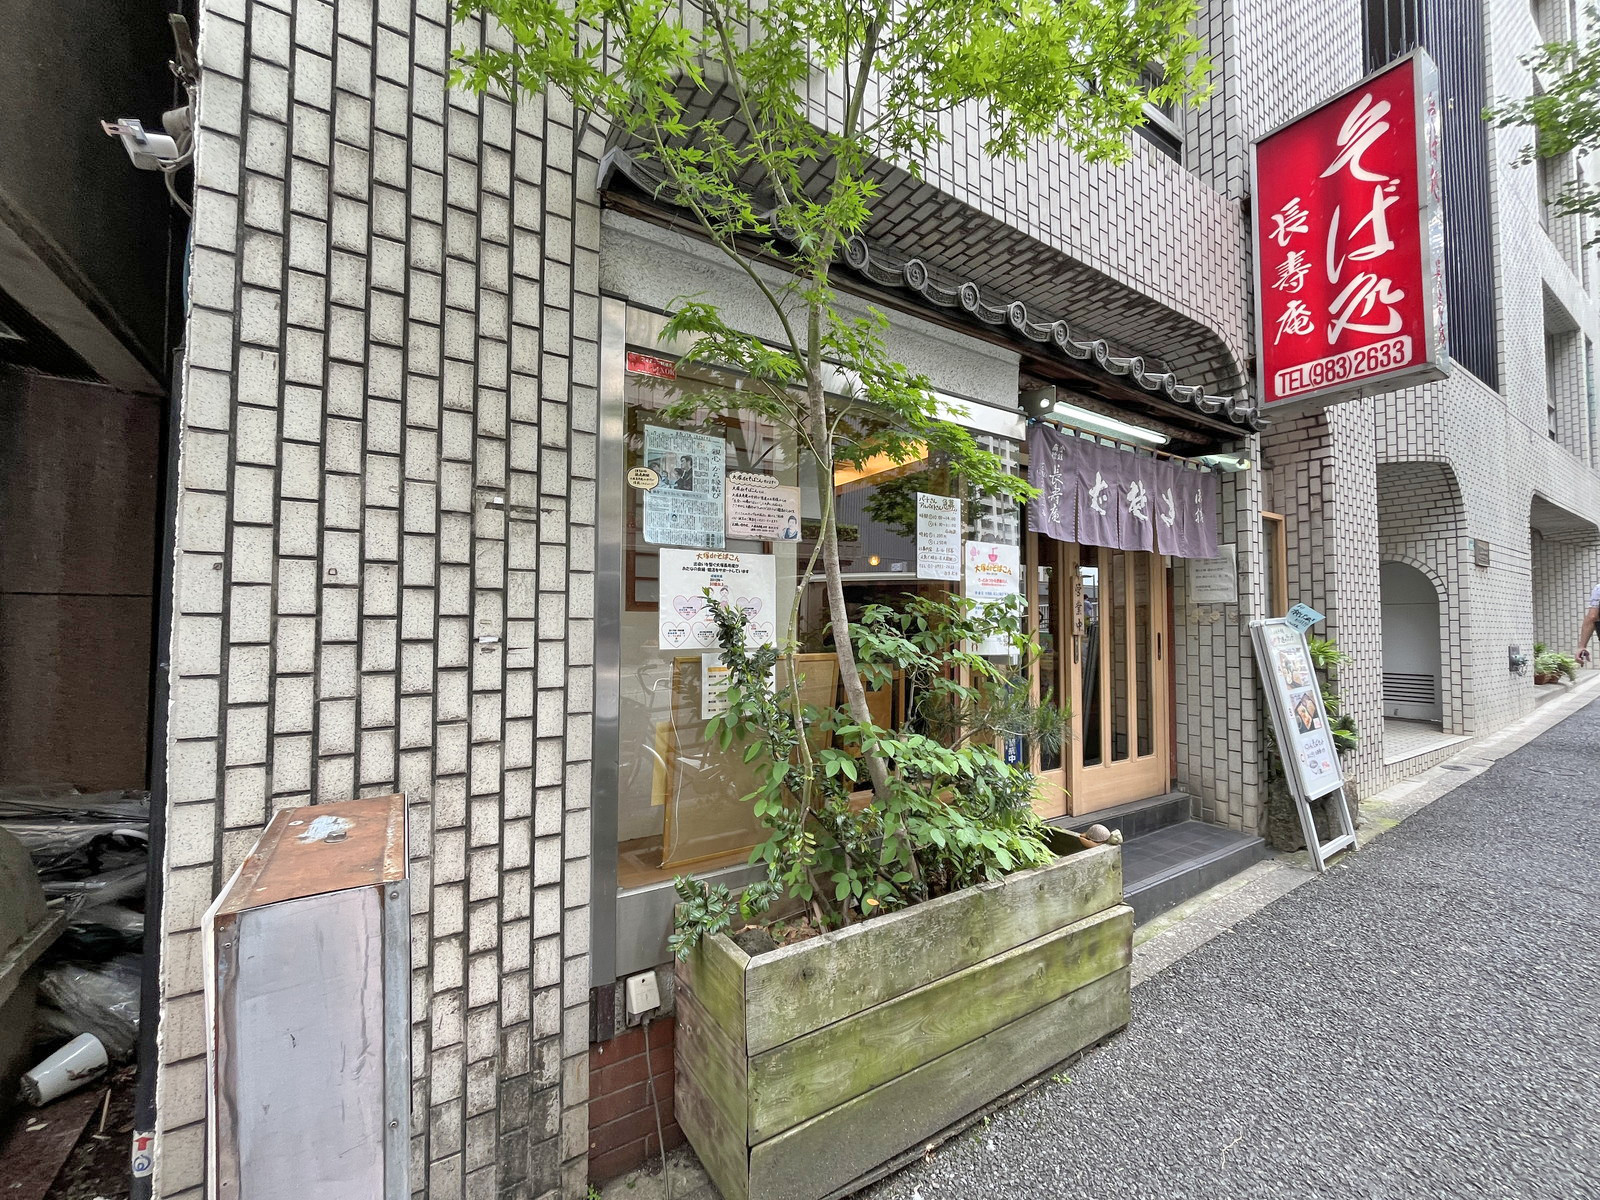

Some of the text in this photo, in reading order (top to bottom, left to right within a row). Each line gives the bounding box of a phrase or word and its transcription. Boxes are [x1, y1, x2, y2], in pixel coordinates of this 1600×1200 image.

[1320, 93, 1405, 345] そば処
[1268, 197, 1316, 346] 長寿庵
[1278, 340, 1405, 390] TEL(983)2633
[1048, 464, 1063, 524] 長寿庵
